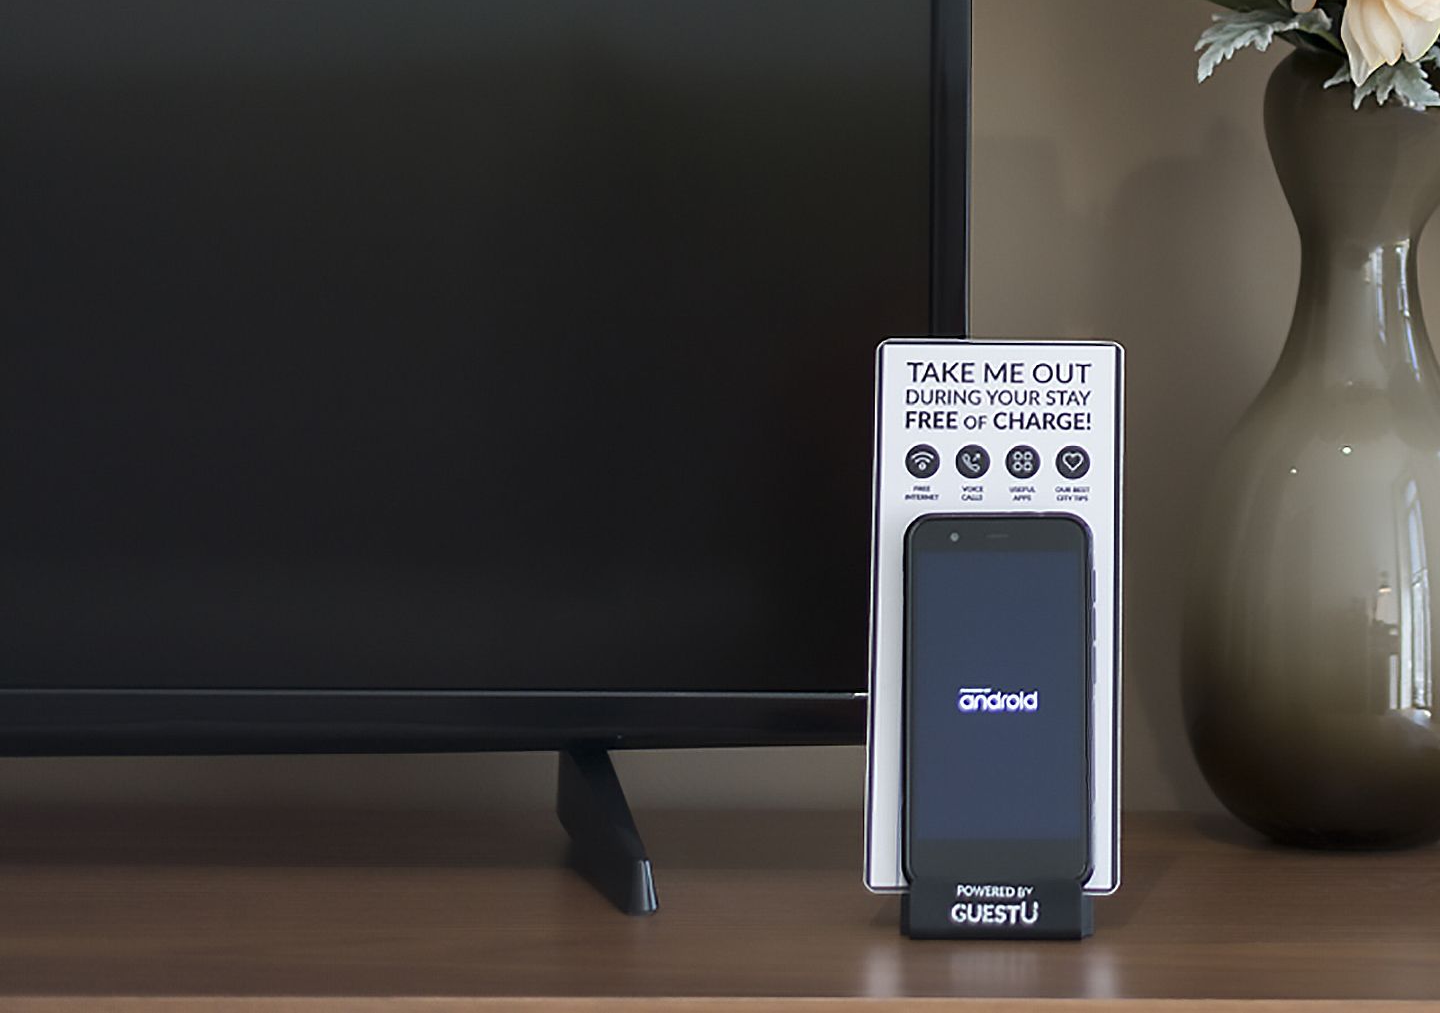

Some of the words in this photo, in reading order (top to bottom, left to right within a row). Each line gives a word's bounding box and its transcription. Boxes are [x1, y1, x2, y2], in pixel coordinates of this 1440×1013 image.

[906, 361, 975, 384] TAKE
[984, 362, 1025, 384] ME
[1032, 363, 1092, 384] OUT
[905, 389, 982, 406] DURING
[986, 390, 1041, 406] YOUR
[1045, 390, 1091, 406] STAY
[905, 410, 958, 430] FREE
[963, 415, 988, 430] OF
[993, 412, 1091, 430] CHARGE!
[959, 691, 1038, 711] android
[957, 884, 1015, 897] POWERED
[1017, 886, 1034, 898] BY
